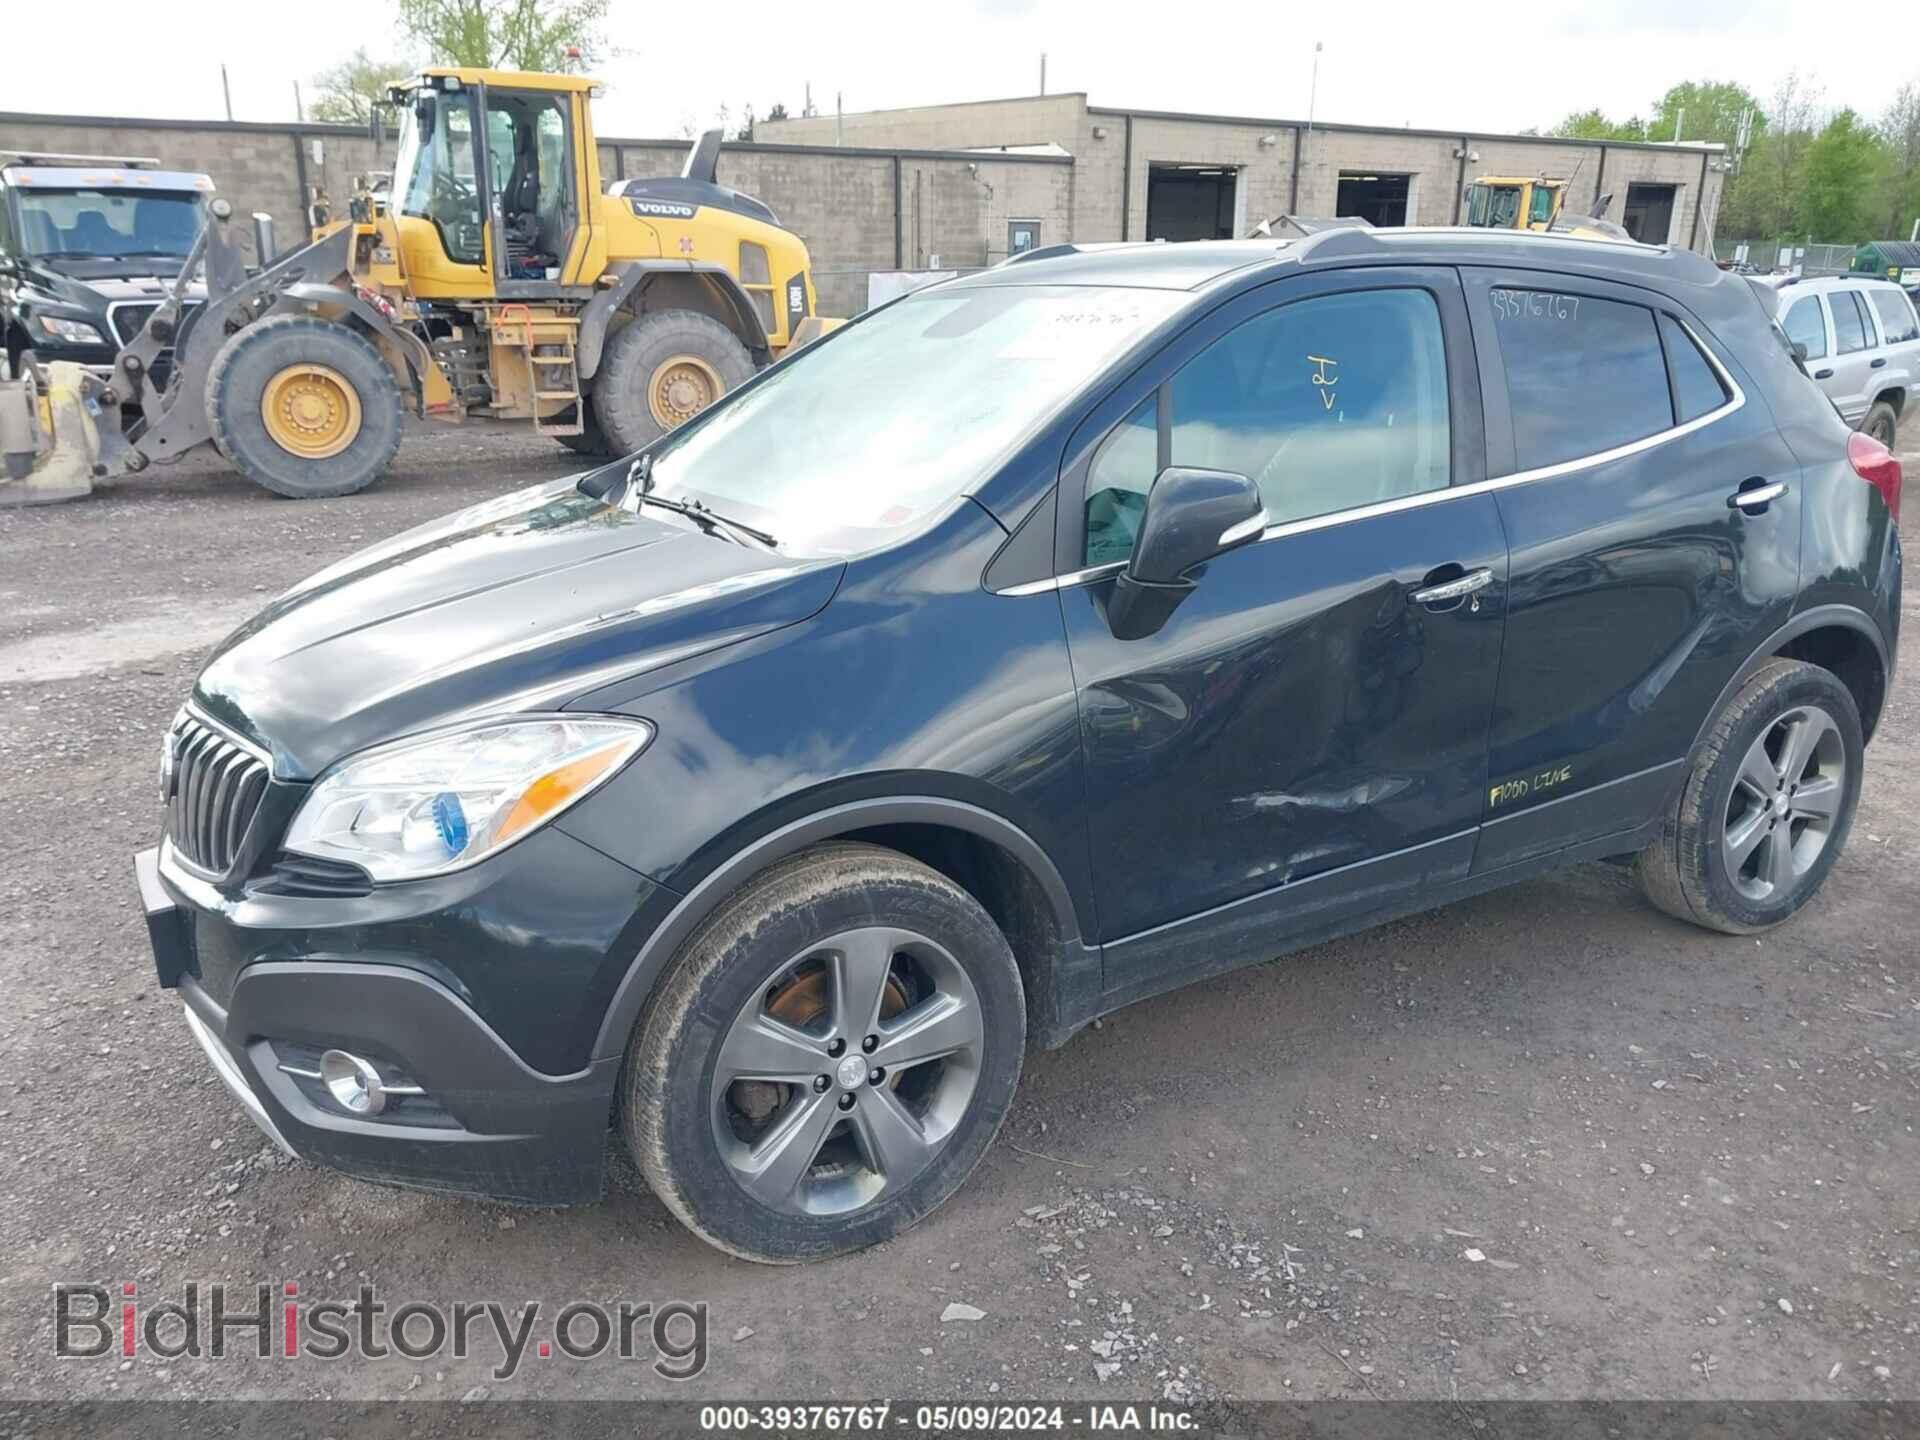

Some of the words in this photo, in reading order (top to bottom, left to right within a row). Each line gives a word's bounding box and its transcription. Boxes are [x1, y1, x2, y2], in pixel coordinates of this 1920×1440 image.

[636, 202, 693, 216] VOLVO
[1490, 289, 1580, 320] 39376767
[1534, 764, 1572, 791] LINE
